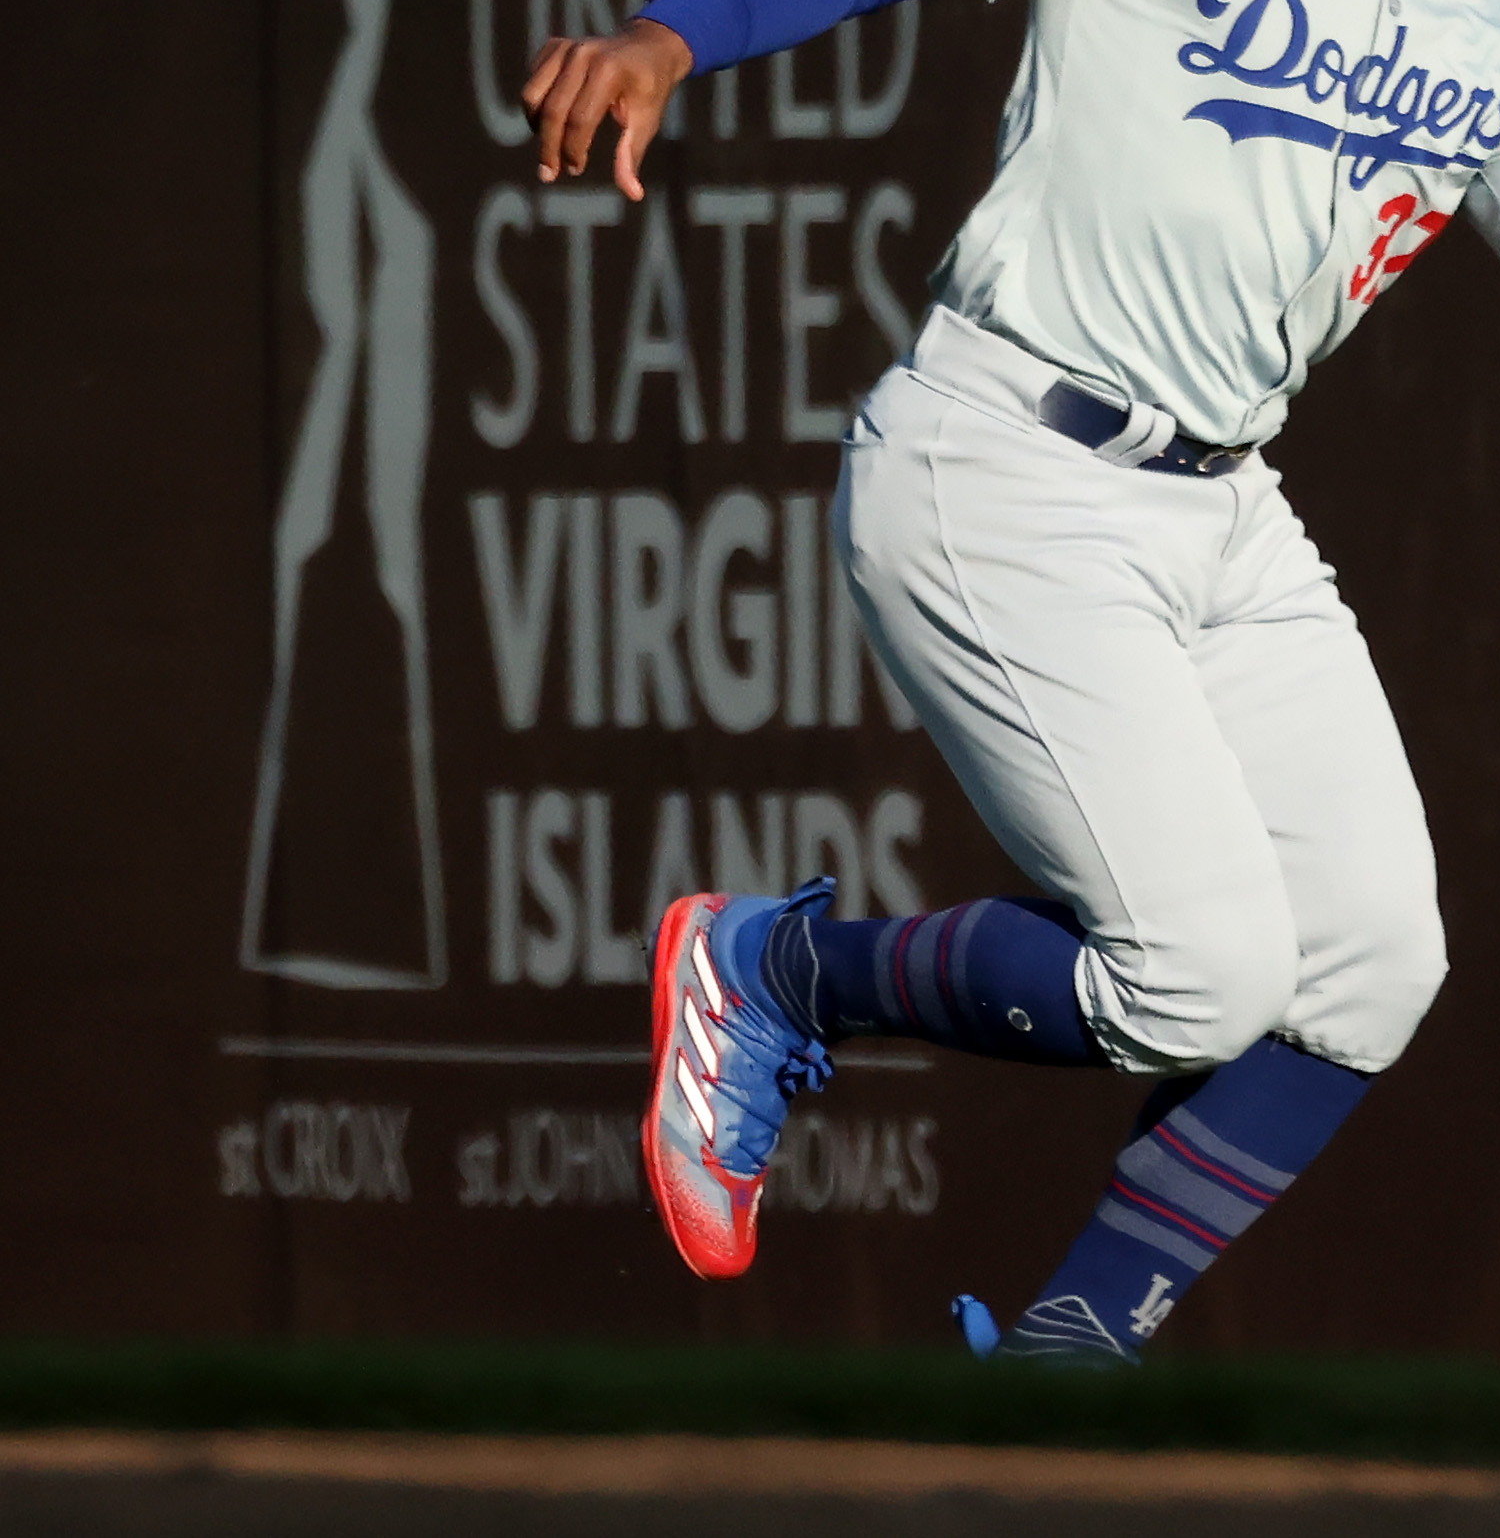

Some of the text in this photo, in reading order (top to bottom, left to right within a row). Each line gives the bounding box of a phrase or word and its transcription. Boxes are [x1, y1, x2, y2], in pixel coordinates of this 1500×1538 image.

[468, 181, 918, 450] STATES
[486, 785, 928, 988] ISLANDS
[760, 1112, 940, 1215] HOMAS
